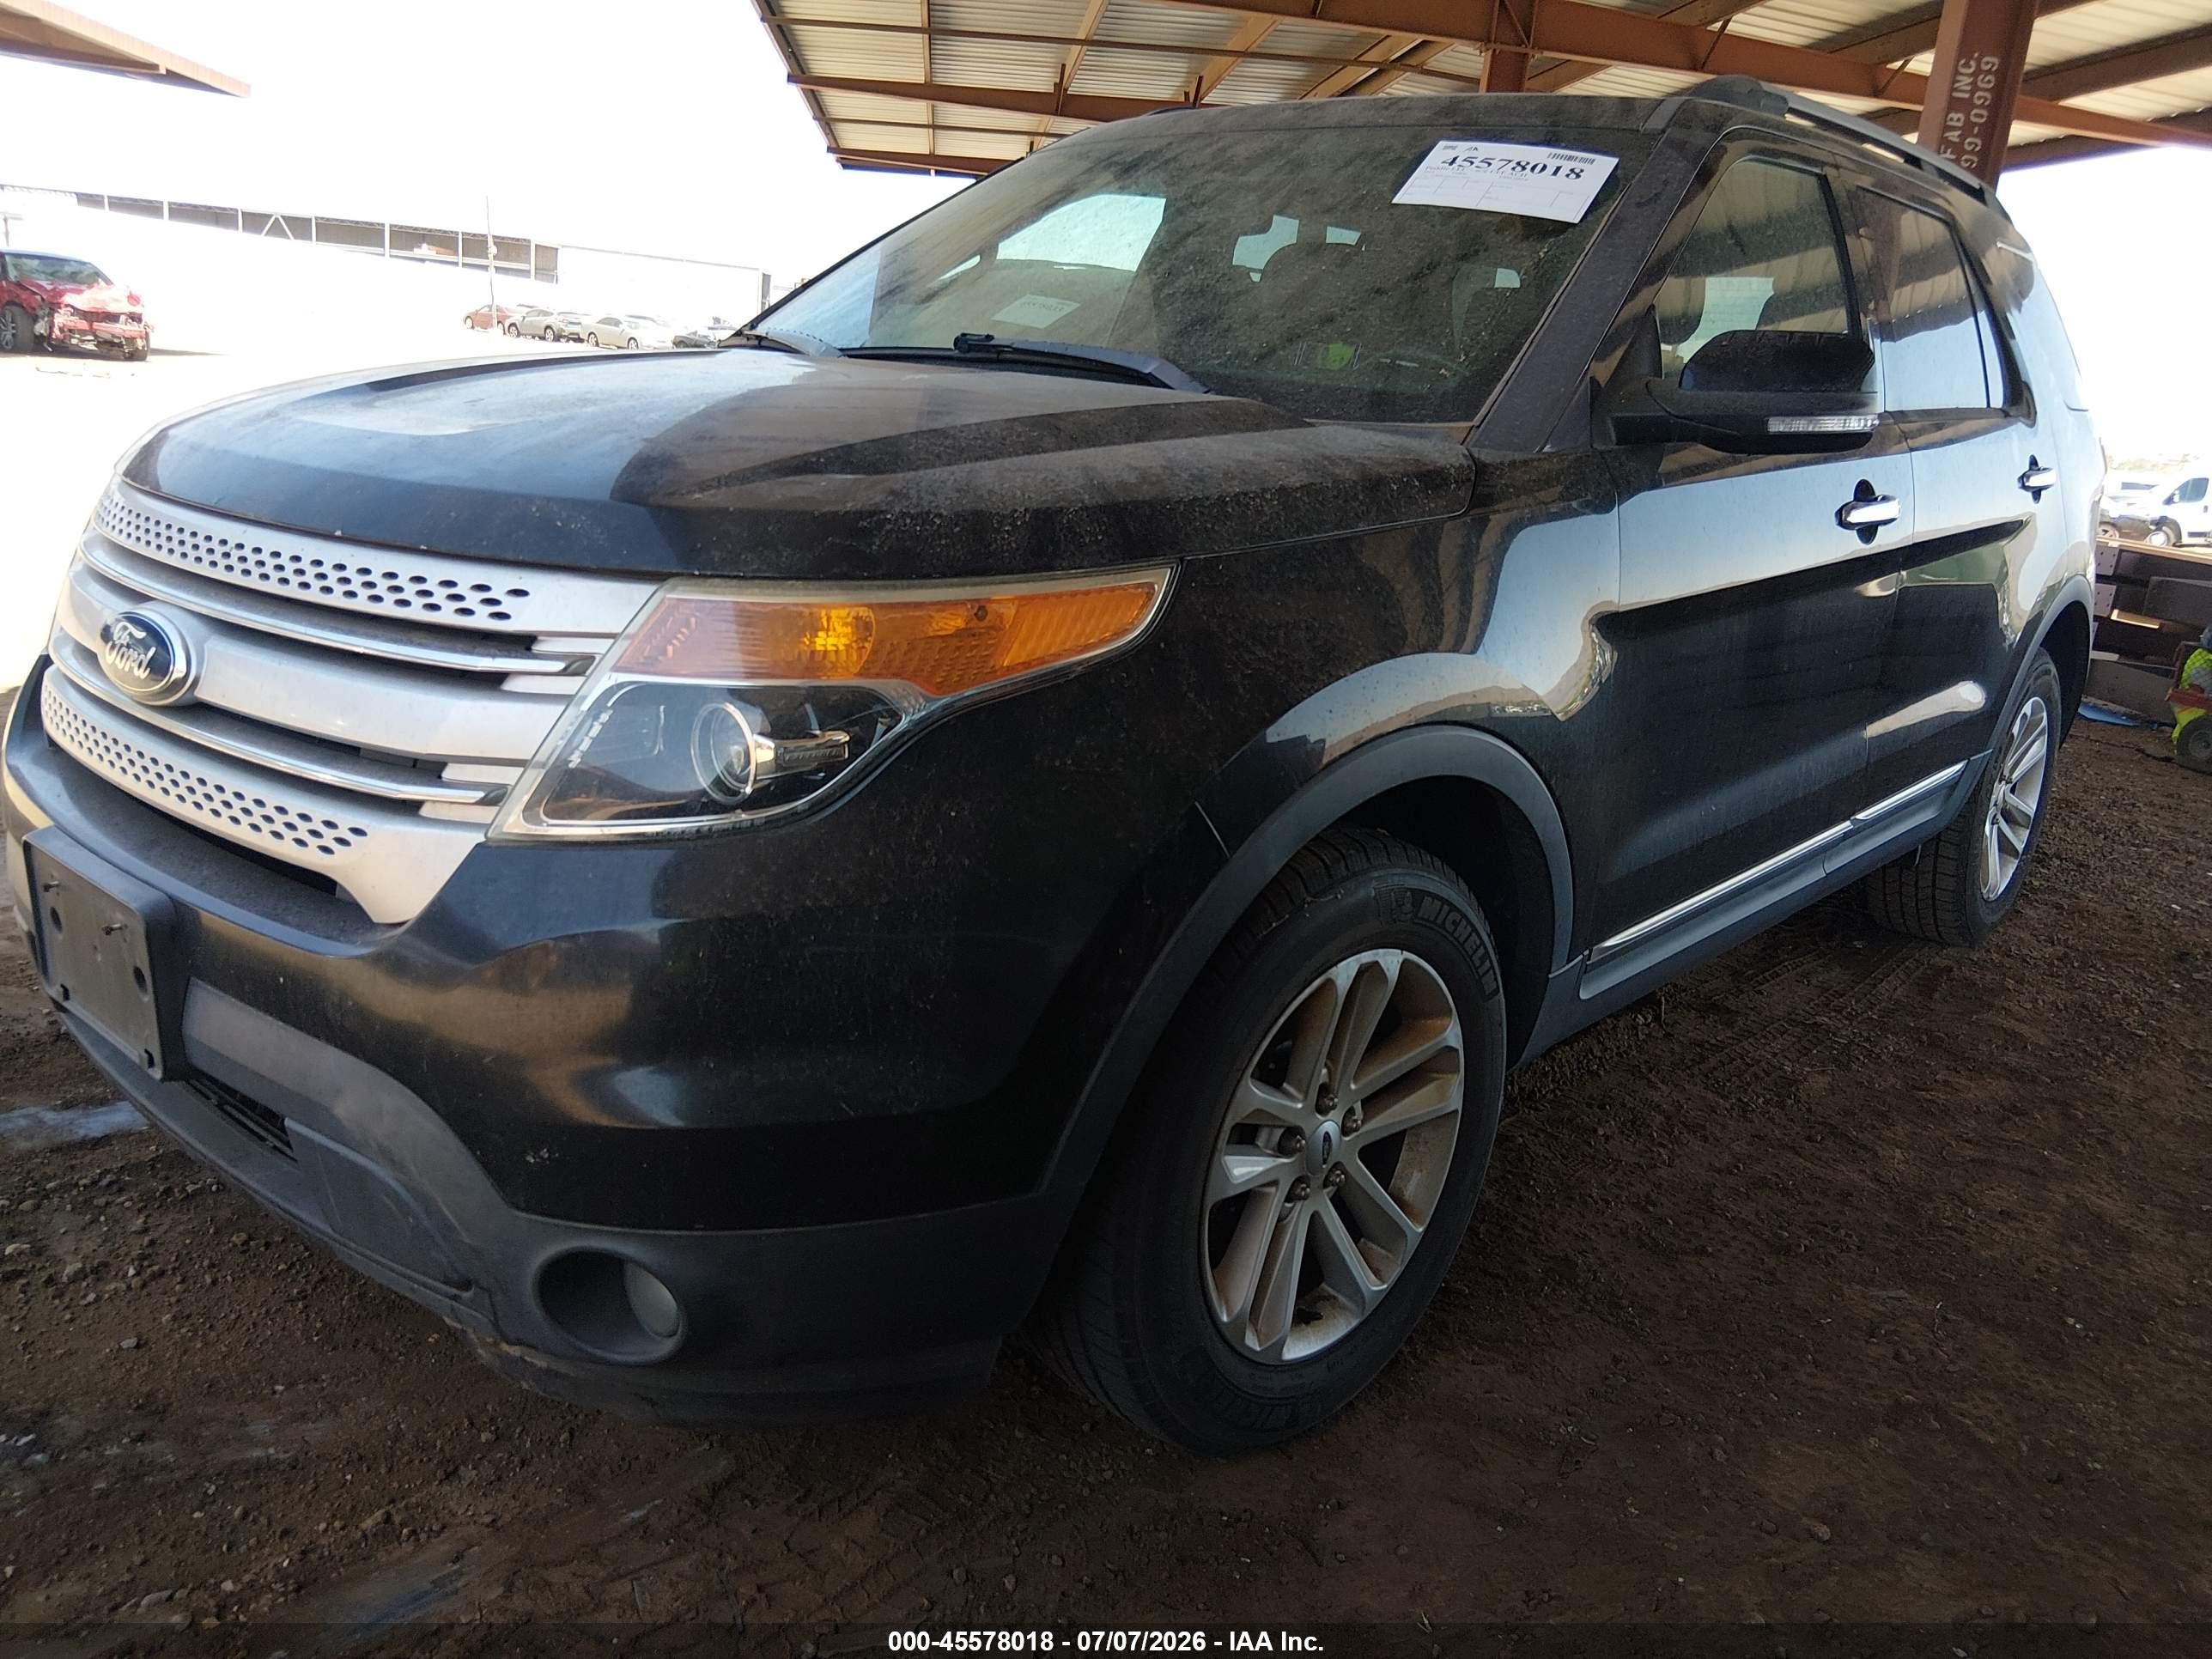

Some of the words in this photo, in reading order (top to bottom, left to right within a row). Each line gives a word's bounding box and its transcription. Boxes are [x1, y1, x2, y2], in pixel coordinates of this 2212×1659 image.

[1952, 52, 1978, 99] INC.
[1940, 112, 1965, 160] FAB
[1441, 155, 1585, 181] 45578018
[106, 621, 156, 680] Ford
[1418, 896, 1499, 997] MICHELIN
